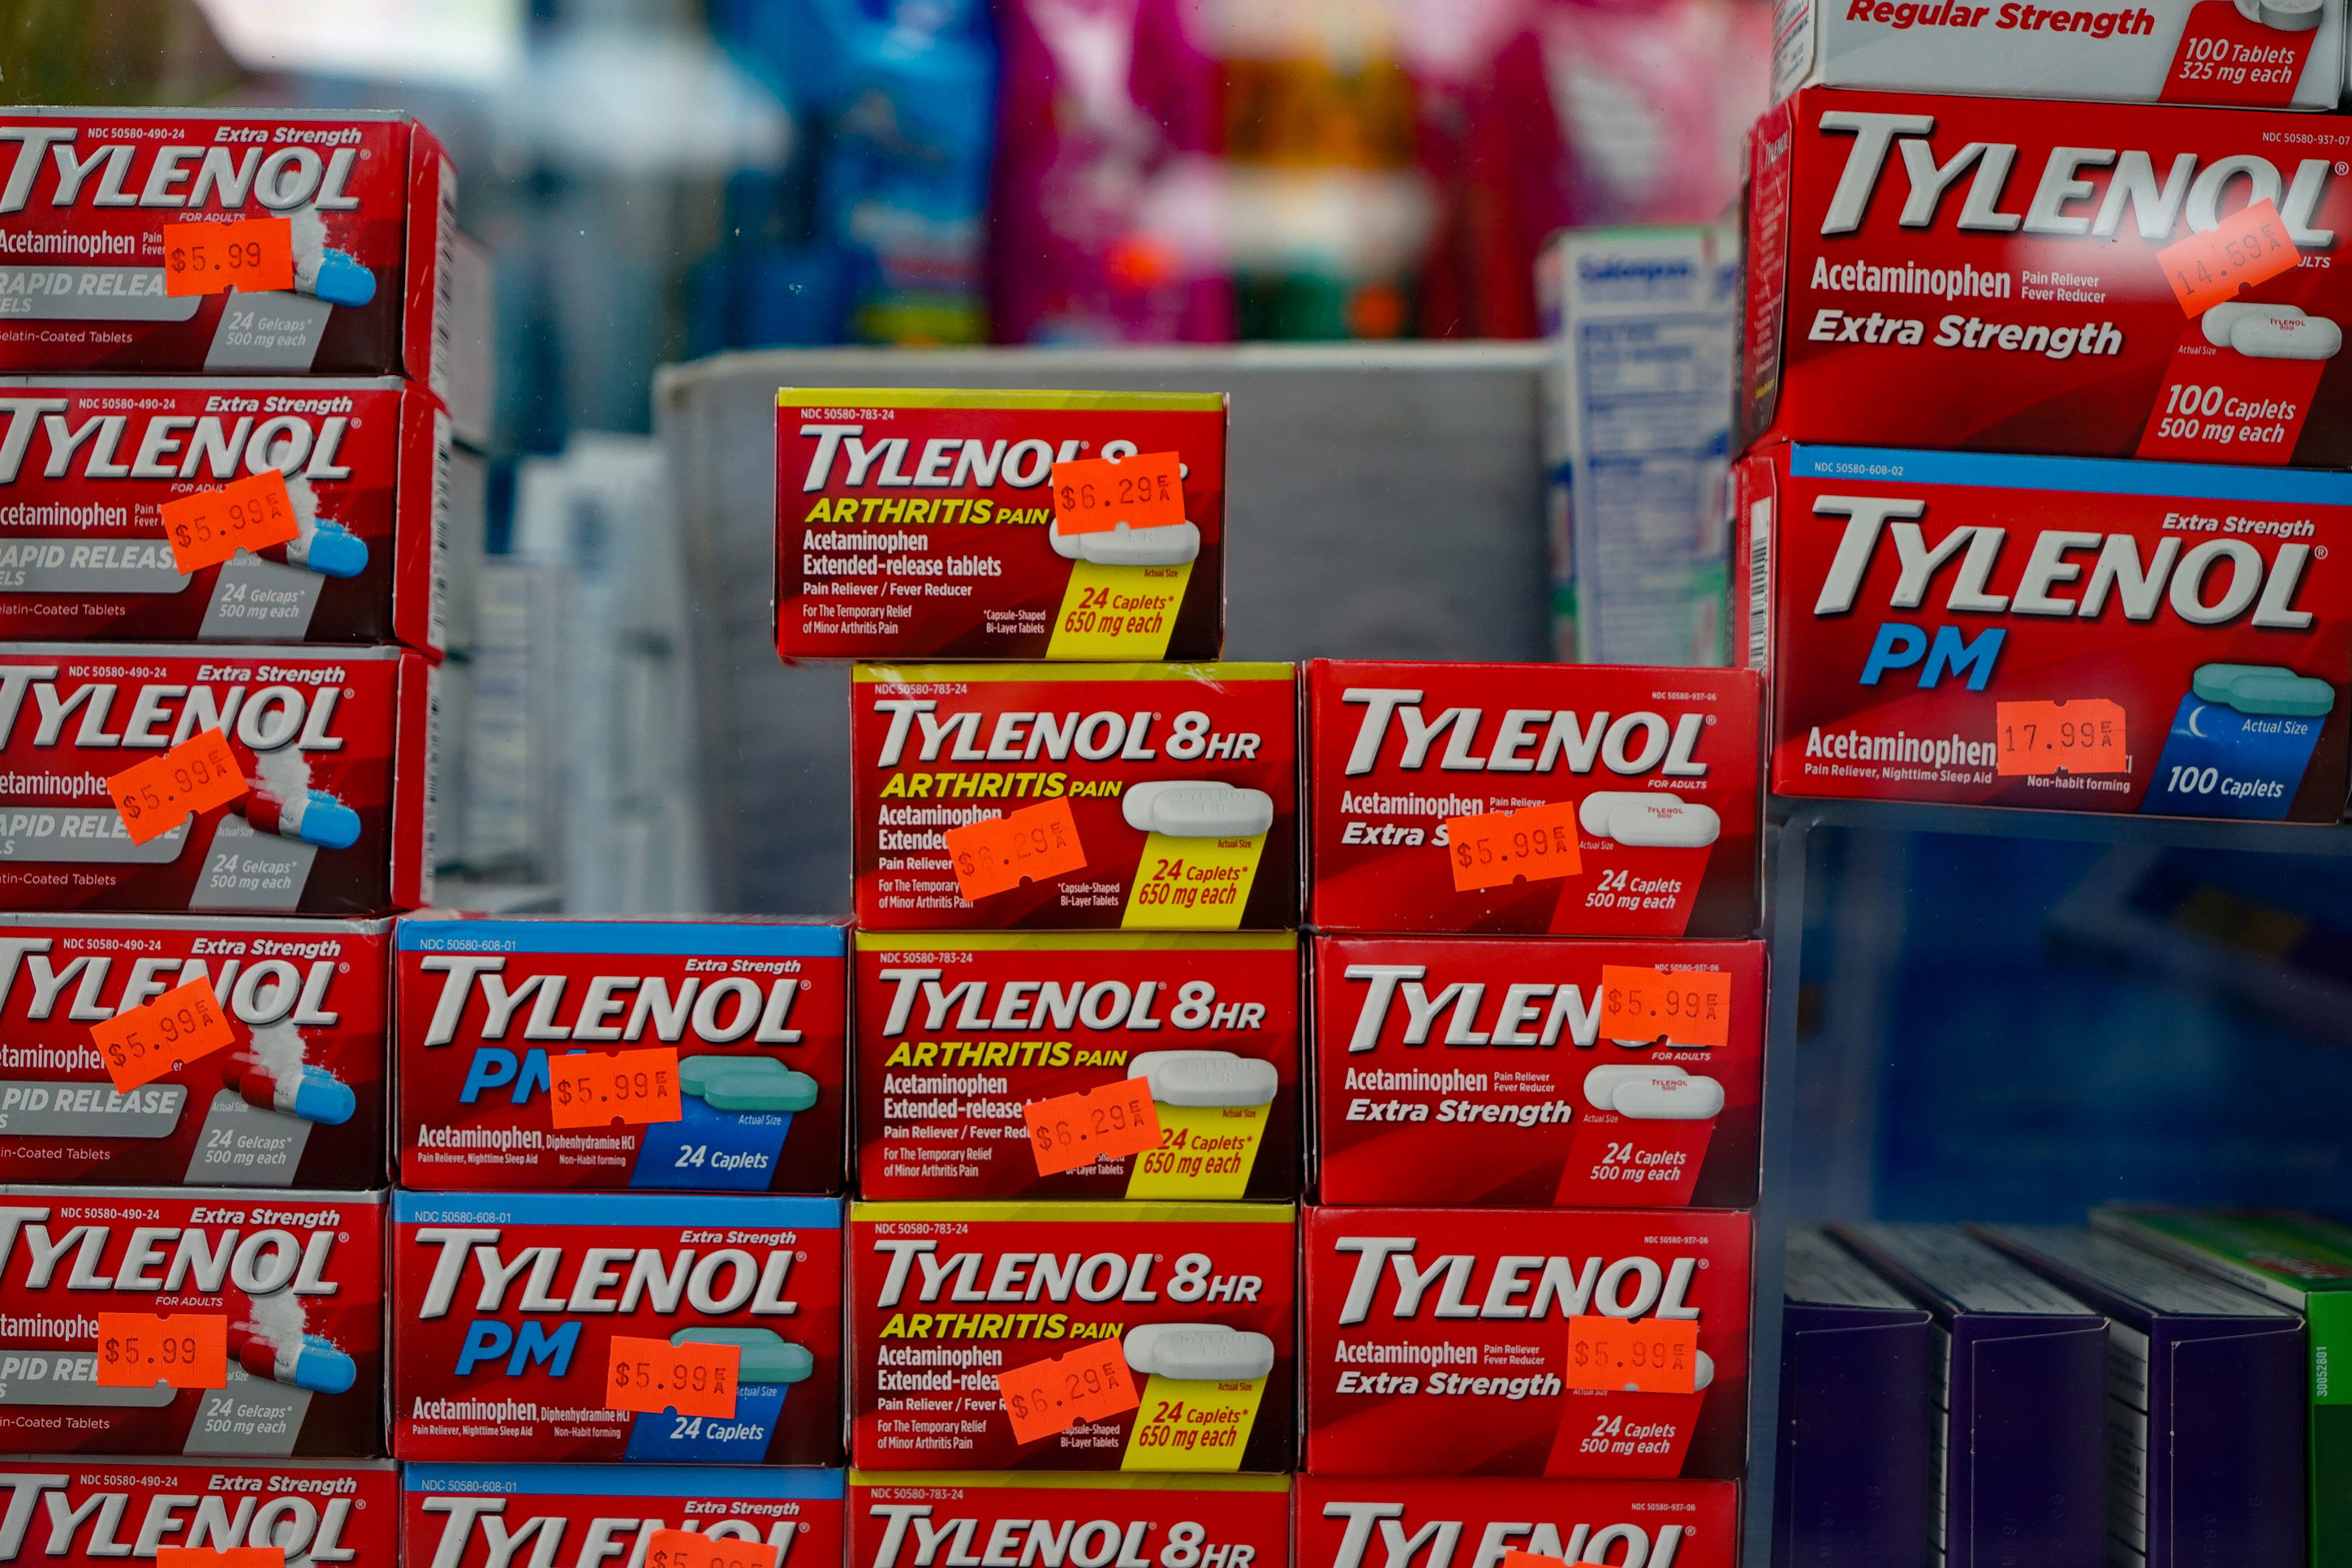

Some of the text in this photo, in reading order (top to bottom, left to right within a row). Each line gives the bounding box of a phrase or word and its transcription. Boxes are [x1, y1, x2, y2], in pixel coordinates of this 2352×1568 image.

[1996, 2, 2155, 38] Strength
[2186, 40, 2295, 65] 100 Tablets
[2180, 62, 2292, 84] 325 mg each
[88, 127, 361, 144] NDC 50580-490-24 Extra Strength
[2285, 133, 2350, 145] 50580-937-07
[0, 127, 360, 213] TYLENOL
[1820, 111, 2335, 247] TYLENOL
[1811, 257, 2100, 299] Acetaminophen Pain Reliever
[229, 312, 253, 330] 24
[89, 331, 132, 342] Tablets
[1808, 310, 2123, 360] Extra Strength
[205, 396, 353, 414] Extra Strength
[2165, 385, 2297, 420] 100 Caplets
[0, 398, 351, 484] TYLENOL
[1815, 461, 1904, 476] NDC 50580-608-02
[805, 498, 1049, 524] ARTHRITIS PAIN
[2163, 514, 2315, 538] Extra Strength
[803, 555, 1002, 575] Extended-release tablets
[1812, 495, 2313, 627] TYLENOL
[1079, 588, 1108, 610] 24
[219, 604, 299, 619] 500 mg each
[803, 605, 911, 620] For The Temporary Relief
[1859, 622, 2006, 690] PM
[92, 666, 166, 678] 50580-490-24
[898, 684, 967, 695] 50580-783-24
[874, 700, 1156, 766] TYLENOL
[1342, 688, 1707, 775] TYLENOL
[2242, 718, 2308, 734] Actual Size
[2027, 774, 2130, 794] Non-habit forming
[2168, 766, 2284, 799] 100 Caplets
[1341, 791, 1483, 818] Acetaminophen
[213, 855, 237, 872] 24
[1597, 870, 1682, 895] 24 Caplets
[1139, 883, 1236, 908] 650 mg each
[192, 938, 340, 958] Extra Strength
[420, 939, 516, 951] NDC 50580-608-01
[420, 956, 802, 1046] TYLENOL
[879, 969, 1161, 1036] TYLENOL
[885, 1041, 1073, 1066] ARTHRITIS
[1652, 1053, 1711, 1061] FOR ADULTS
[884, 1074, 1007, 1095] Acetaminophen
[1494, 1071, 1549, 1082] Pain Reliever
[1494, 1083, 1555, 1092] Fever Reducer
[54, 1089, 179, 1114] RELEASE
[1346, 1099, 1572, 1126] Extra Strength
[546, 1136, 620, 1152] Diphenhydramine
[205, 1150, 286, 1165] 500 mg each
[418, 1152, 467, 1165] Pain Reliever,
[675, 1146, 769, 1170] 24 Caplets
[884, 1165, 979, 1178] of Minor Arthritis Pain
[680, 1231, 796, 1246] Extra Strength
[416, 1228, 798, 1319] TYLENOL
[874, 1240, 1156, 1307] TYLENOL
[1334, 1237, 1700, 1324] TYLENOL
[156, 1297, 222, 1307] FOR ADULTS
[879, 1314, 1123, 1338] ARTHRITIS PAIN
[454, 1320, 582, 1376] PM
[1335, 1340, 1478, 1367] Acetaminophen
[2316, 1346, 2328, 1397] 30052801
[1152, 1402, 1182, 1423] 24
[66, 1418, 110, 1430] Tablets
[463, 1425, 532, 1437] Nighttime Sleep Aid
[1579, 1438, 1669, 1455] 500 mg each
[103, 1475, 357, 1493] 50580-490-24 Extra Strength
[894, 1488, 963, 1500] 50580-783-24
[448, 1480, 799, 1516] 50580-608-01 Extra Strength
[1631, 1503, 1646, 1511] NDC
[0, 1473, 355, 1561] TYLENOL
[869, 1505, 1152, 1568] TYLENOL
